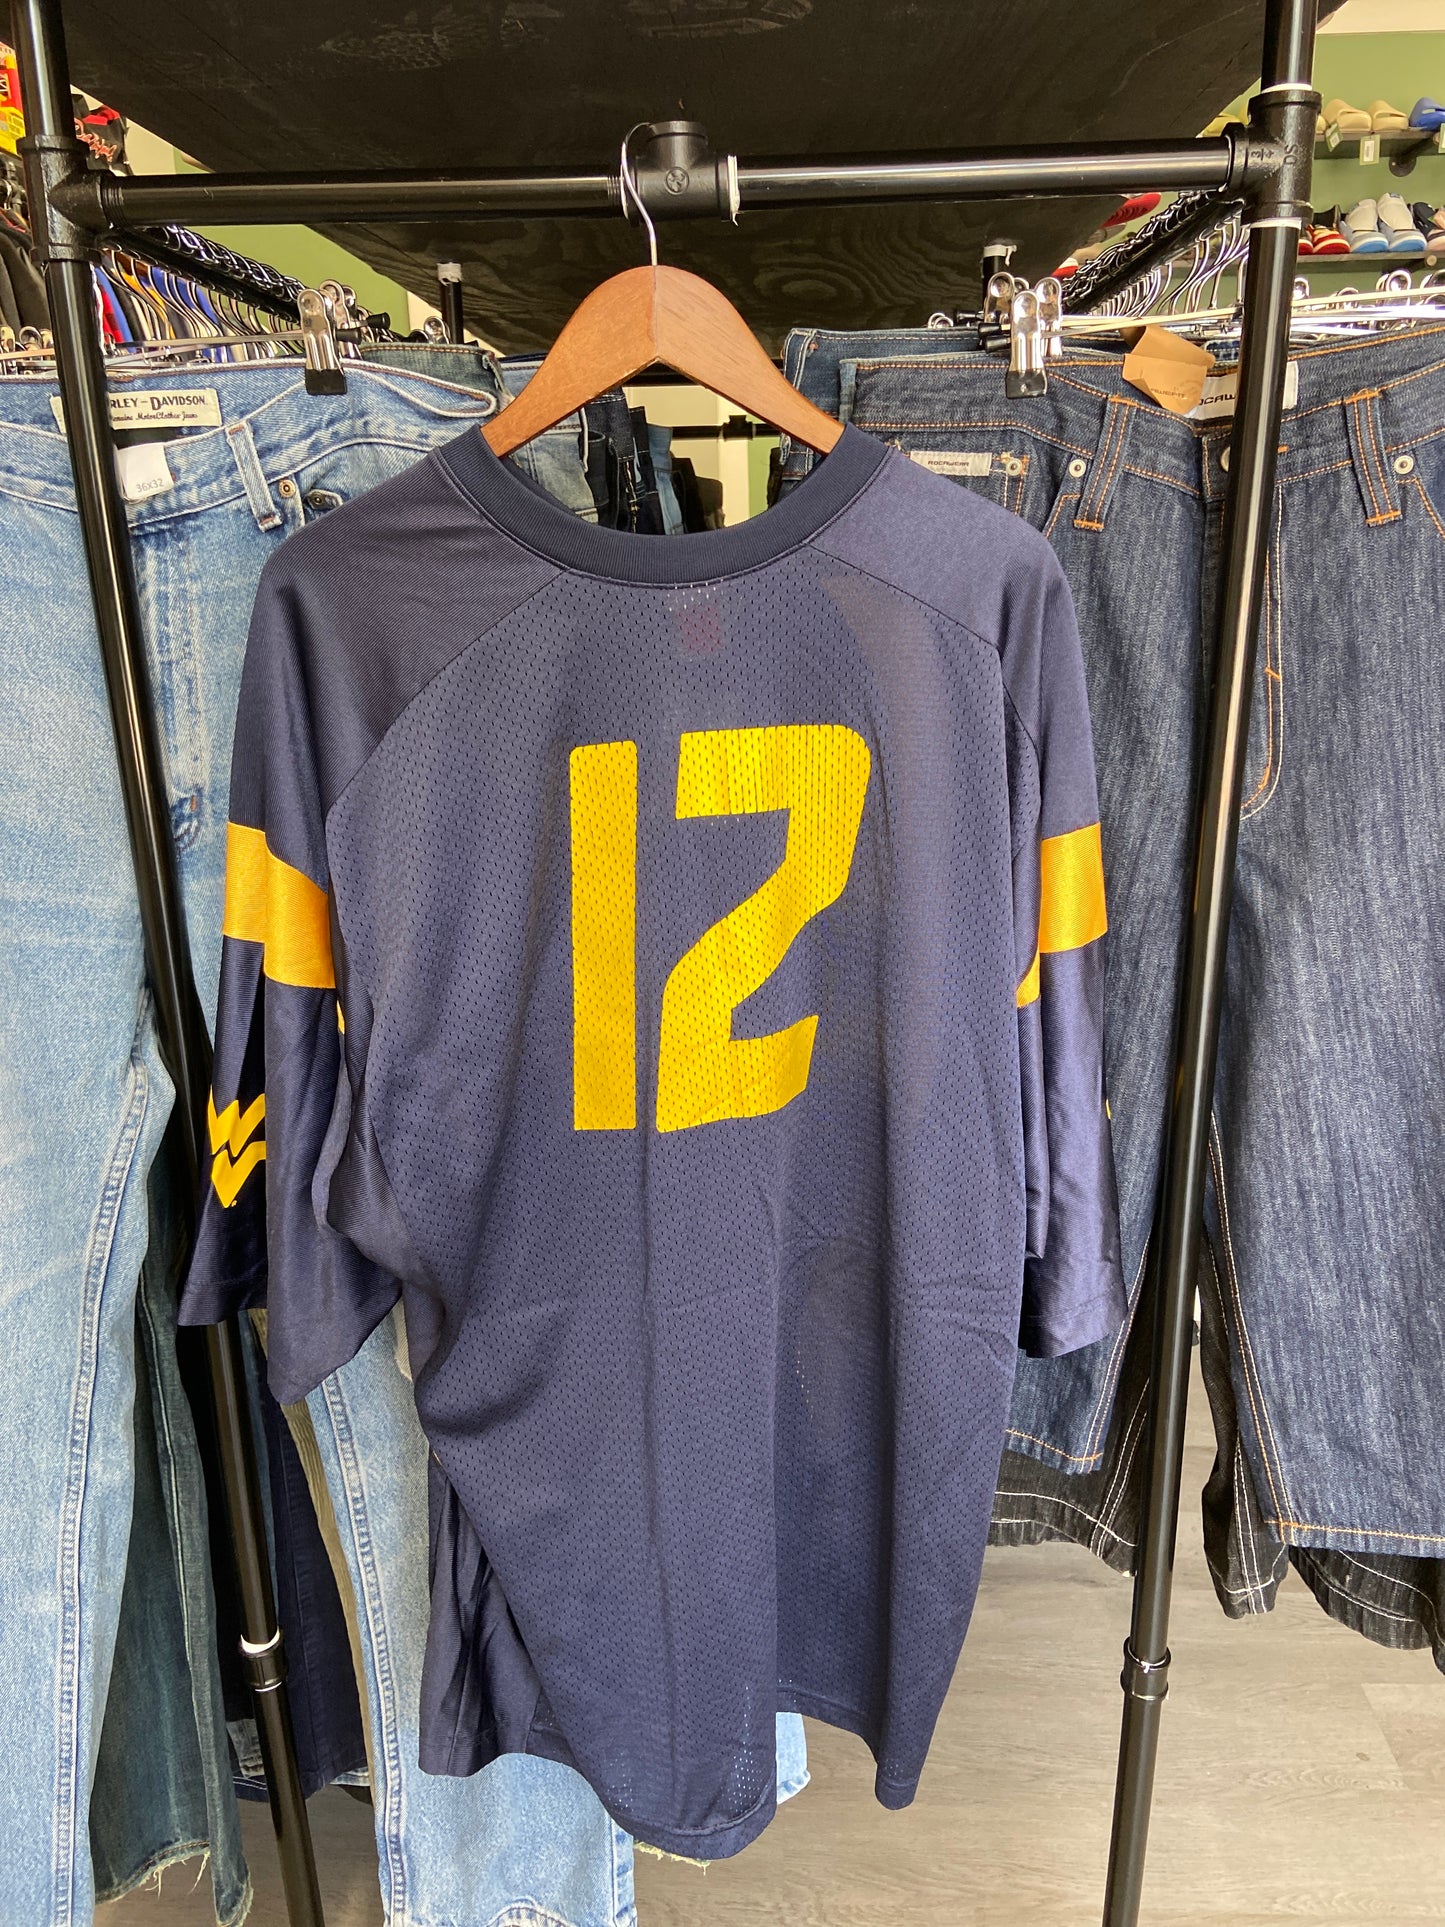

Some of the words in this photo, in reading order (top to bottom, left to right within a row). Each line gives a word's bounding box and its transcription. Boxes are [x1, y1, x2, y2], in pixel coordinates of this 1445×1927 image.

[110, 397, 138, 409] RLEY
[150, 395, 206, 410] DAVIDSON
[112, 414, 134, 422] enuine
[569, 724, 872, 1133] 12
